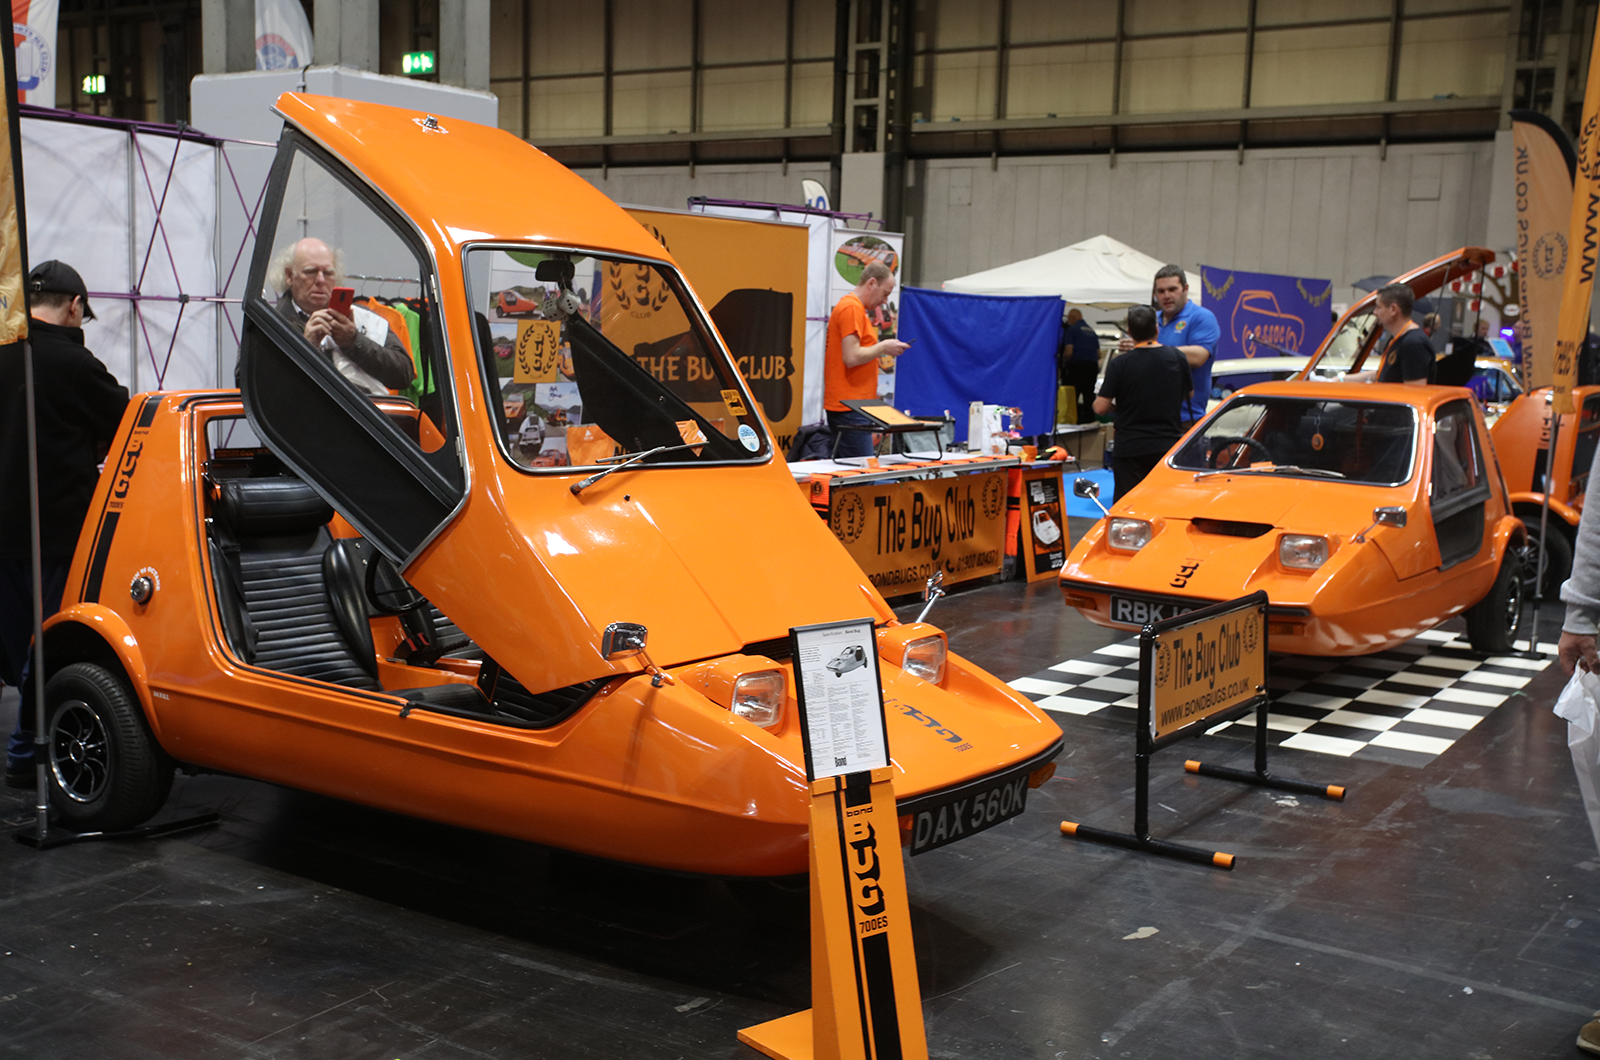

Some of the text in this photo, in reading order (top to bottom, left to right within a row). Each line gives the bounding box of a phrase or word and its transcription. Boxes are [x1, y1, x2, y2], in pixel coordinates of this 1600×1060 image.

[636, 355, 787, 382] THE BU CLUB
[115, 439, 144, 499] BUG
[874, 485, 976, 560] The Bug Club
[1117, 598, 1164, 623] RBK
[1173, 638, 1193, 690] The
[1195, 632, 1216, 690] Bug
[1218, 620, 1241, 673] Club
[1161, 677, 1250, 727] WWW.BONDBUGS.CO.UK
[846, 806, 874, 817] bond
[914, 776, 1028, 850] DAX 560K
[849, 821, 886, 917] BUG
[859, 915, 888, 934] 700ES
